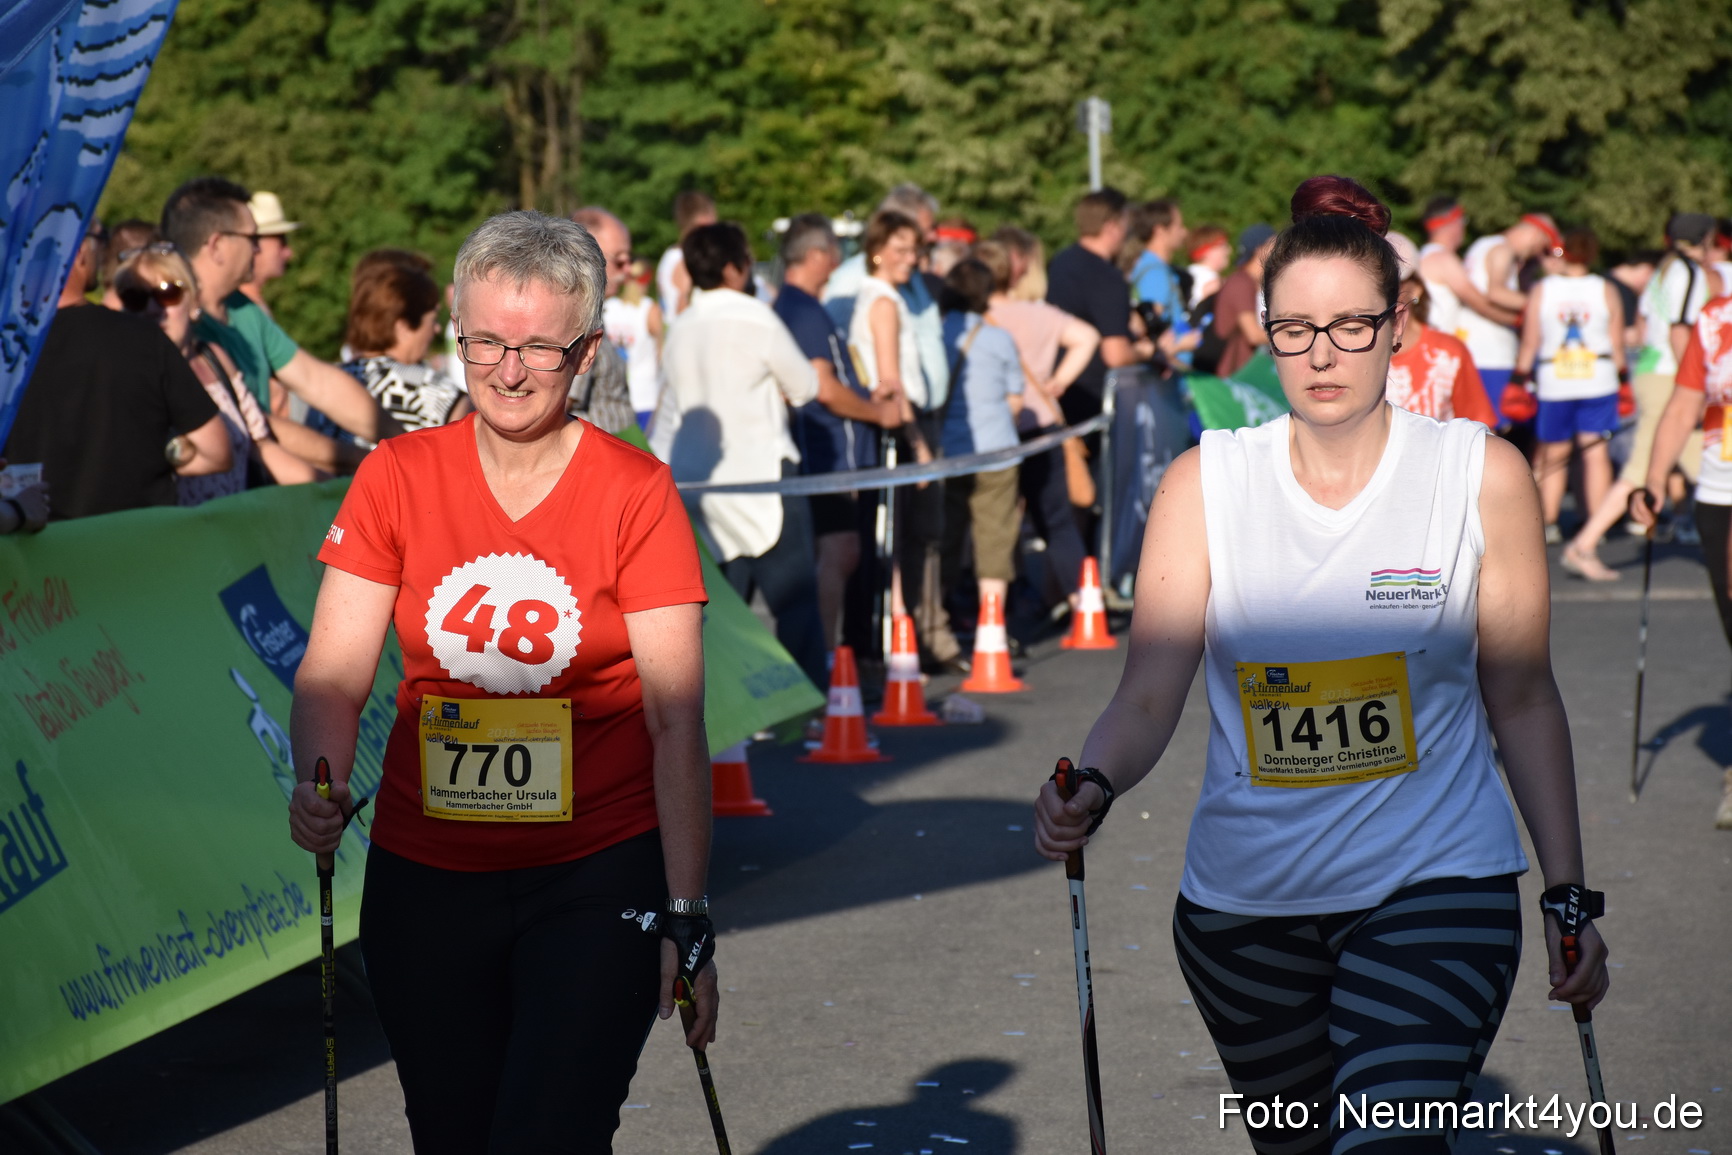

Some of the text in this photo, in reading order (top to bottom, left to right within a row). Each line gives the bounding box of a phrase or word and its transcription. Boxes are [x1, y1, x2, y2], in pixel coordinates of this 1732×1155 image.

[1366, 584, 1448, 601] NeuerMarkt
[1258, 682, 1311, 693] firmenlauf
[1320, 688, 1350, 700] 2018
[1250, 699, 1291, 711] walken
[434, 716, 480, 729] firmenlauf
[1262, 700, 1391, 751] 1416
[426, 732, 458, 745] walken
[487, 729, 517, 738] 2018
[1258, 766, 1294, 774] NeuerMarkt
[1337, 760, 1382, 770] Vermietungs
[1384, 753, 1406, 763] GmbH
[1264, 745, 1397, 767] Dornberger Christine
[444, 744, 532, 788] 770
[430, 786, 557, 801] Hammerbacher Ursula
[446, 801, 533, 811] Hammerbacher GmbH
[1567, 886, 1580, 926] LEKI
[685, 941, 702, 971] LEKI
